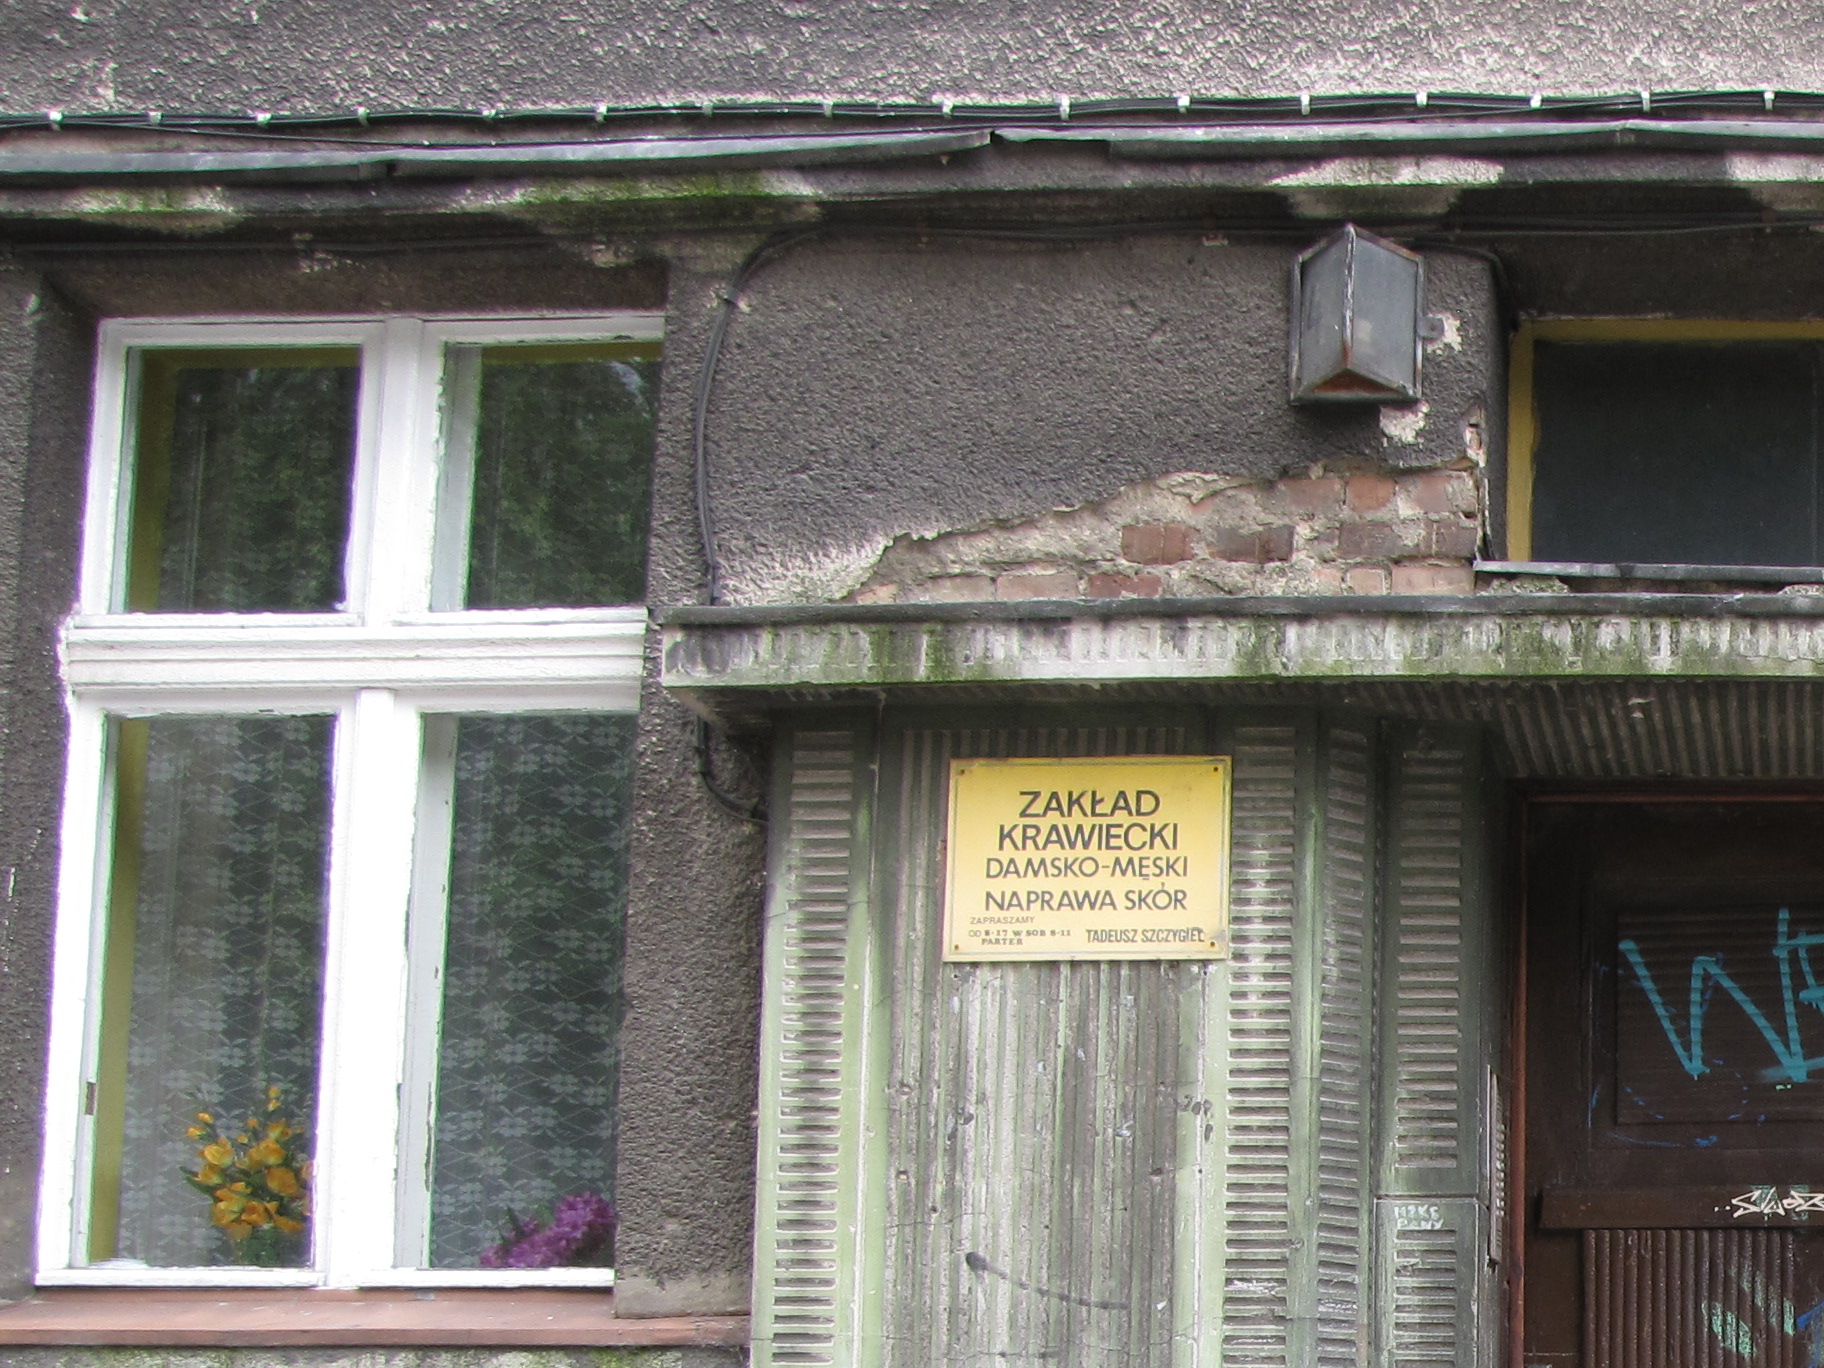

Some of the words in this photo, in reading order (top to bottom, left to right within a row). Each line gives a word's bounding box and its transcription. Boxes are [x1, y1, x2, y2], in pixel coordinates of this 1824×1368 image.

[1019, 790, 1161, 818] ZAKŁAD
[998, 822, 1179, 851] KRAWIECKI
[985, 856, 1188, 881] DAMSKO-MĘSKI
[985, 890, 1119, 911] NAPRAWA
[1124, 882, 1188, 911] SKÓR
[969, 915, 1036, 925] ZAPRASZAMY
[981, 938, 1024, 946] PARTER
[1085, 928, 1139, 943] TADEUSZ
